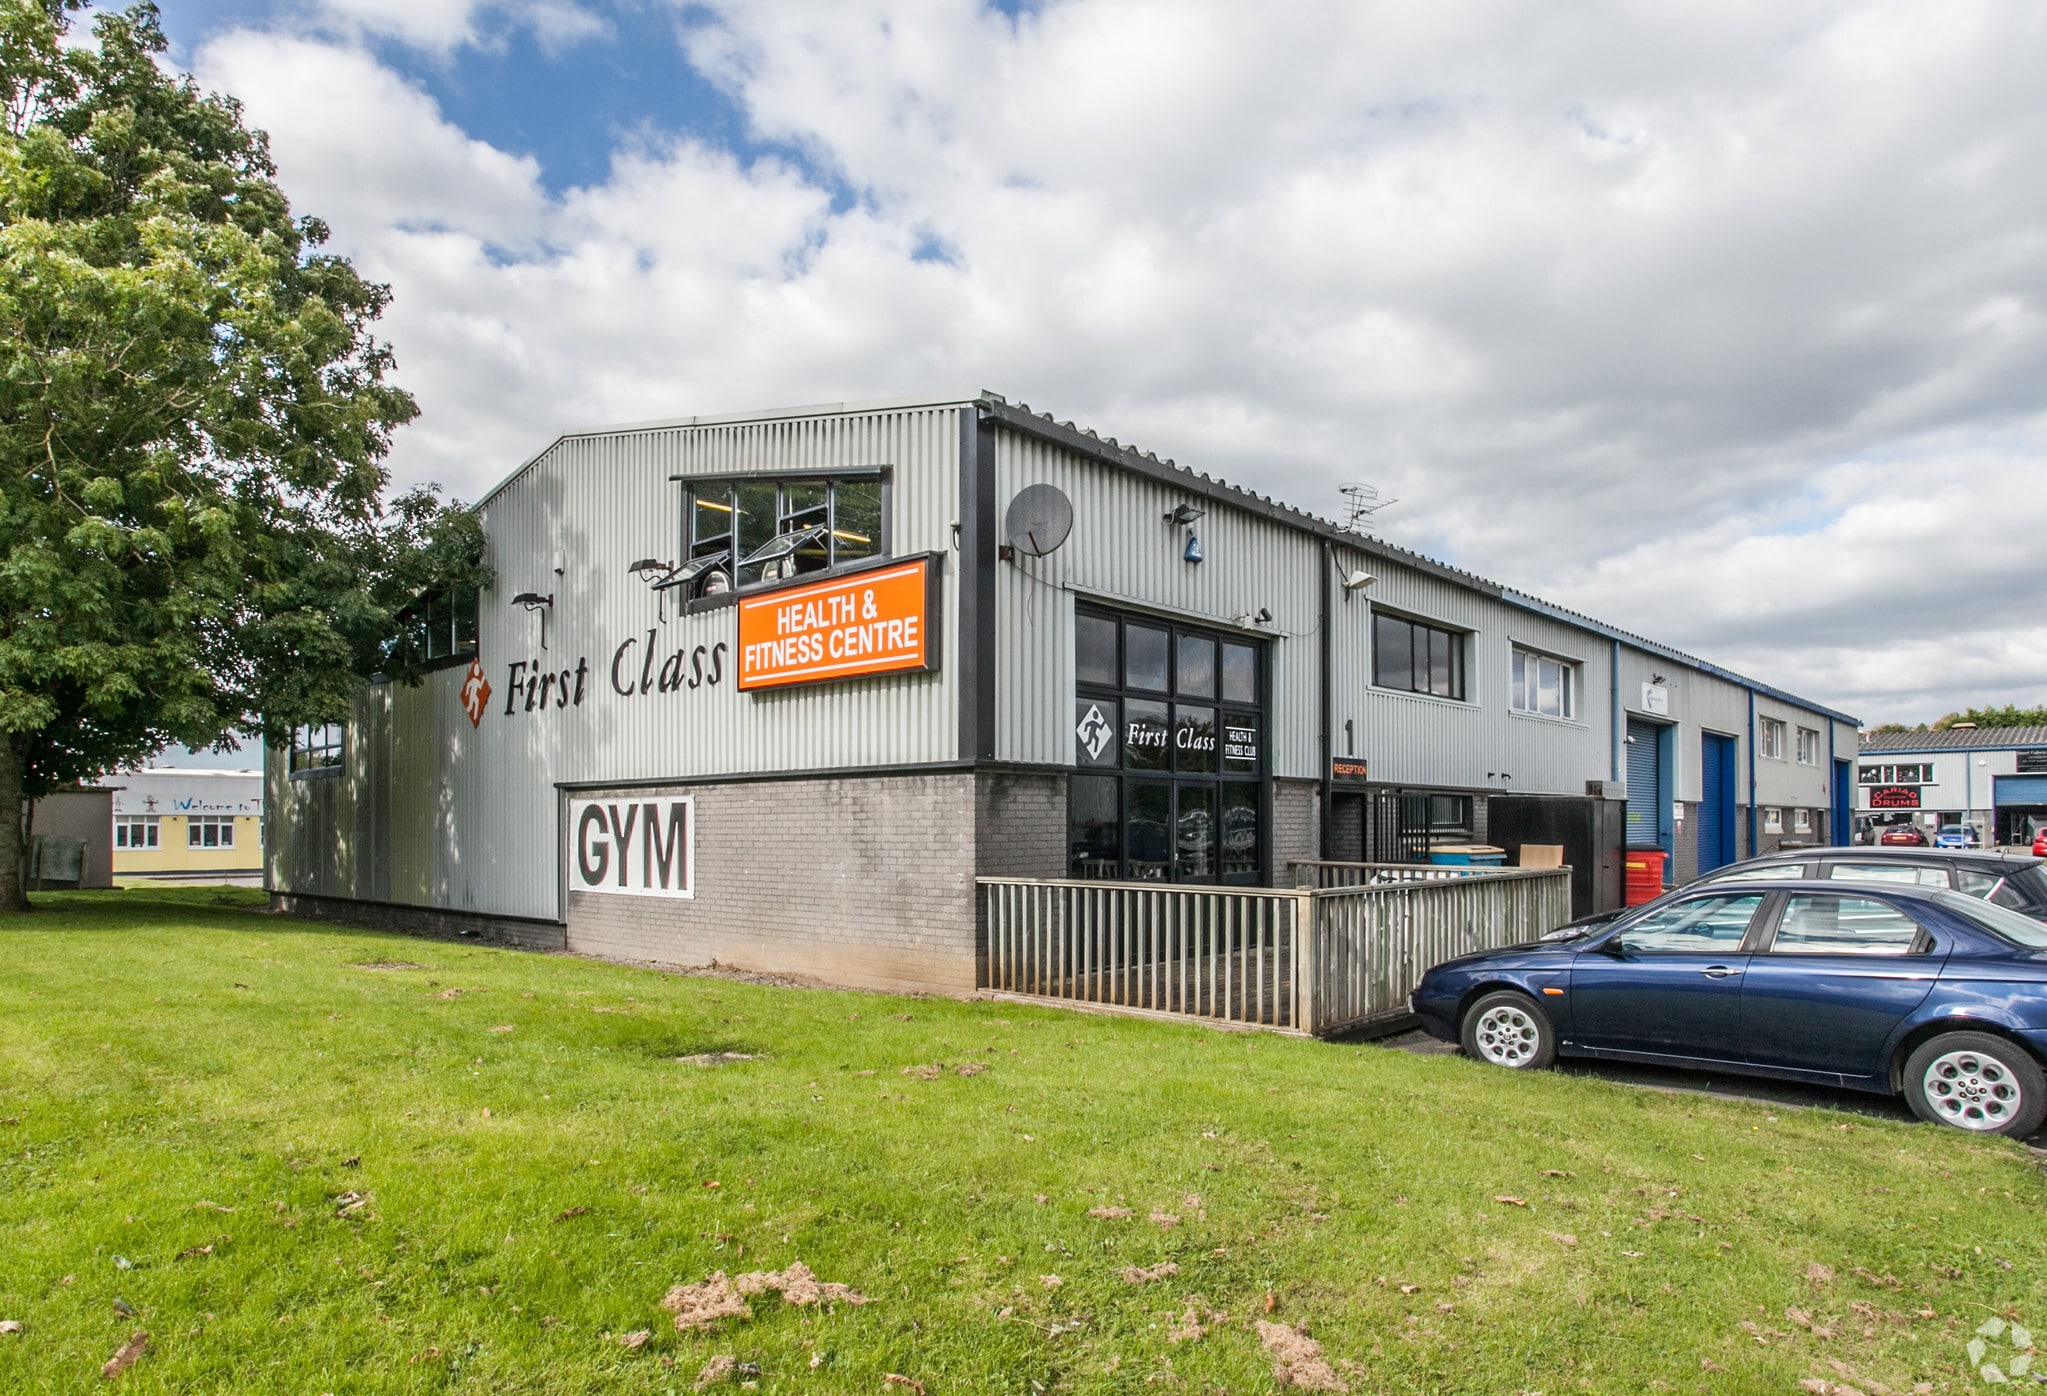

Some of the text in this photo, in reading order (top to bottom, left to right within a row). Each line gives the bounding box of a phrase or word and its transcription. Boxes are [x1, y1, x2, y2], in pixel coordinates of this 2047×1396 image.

[777, 589, 878, 635] HEALTH &
[744, 616, 919, 672] FITNESS CENTRE
[504, 628, 728, 716] First Class
[1127, 723, 1216, 752] First Class
[1229, 730, 1247, 743] HEALTH
[1224, 743, 1257, 757] FITNESS CLUB
[1334, 763, 1367, 776] RECEPTION
[1873, 786, 1918, 799] CARIAD
[173, 796, 233, 811] Welcome
[239, 803, 251, 811] to
[1872, 799, 1920, 807] DRUMS
[577, 802, 688, 891] GYM
